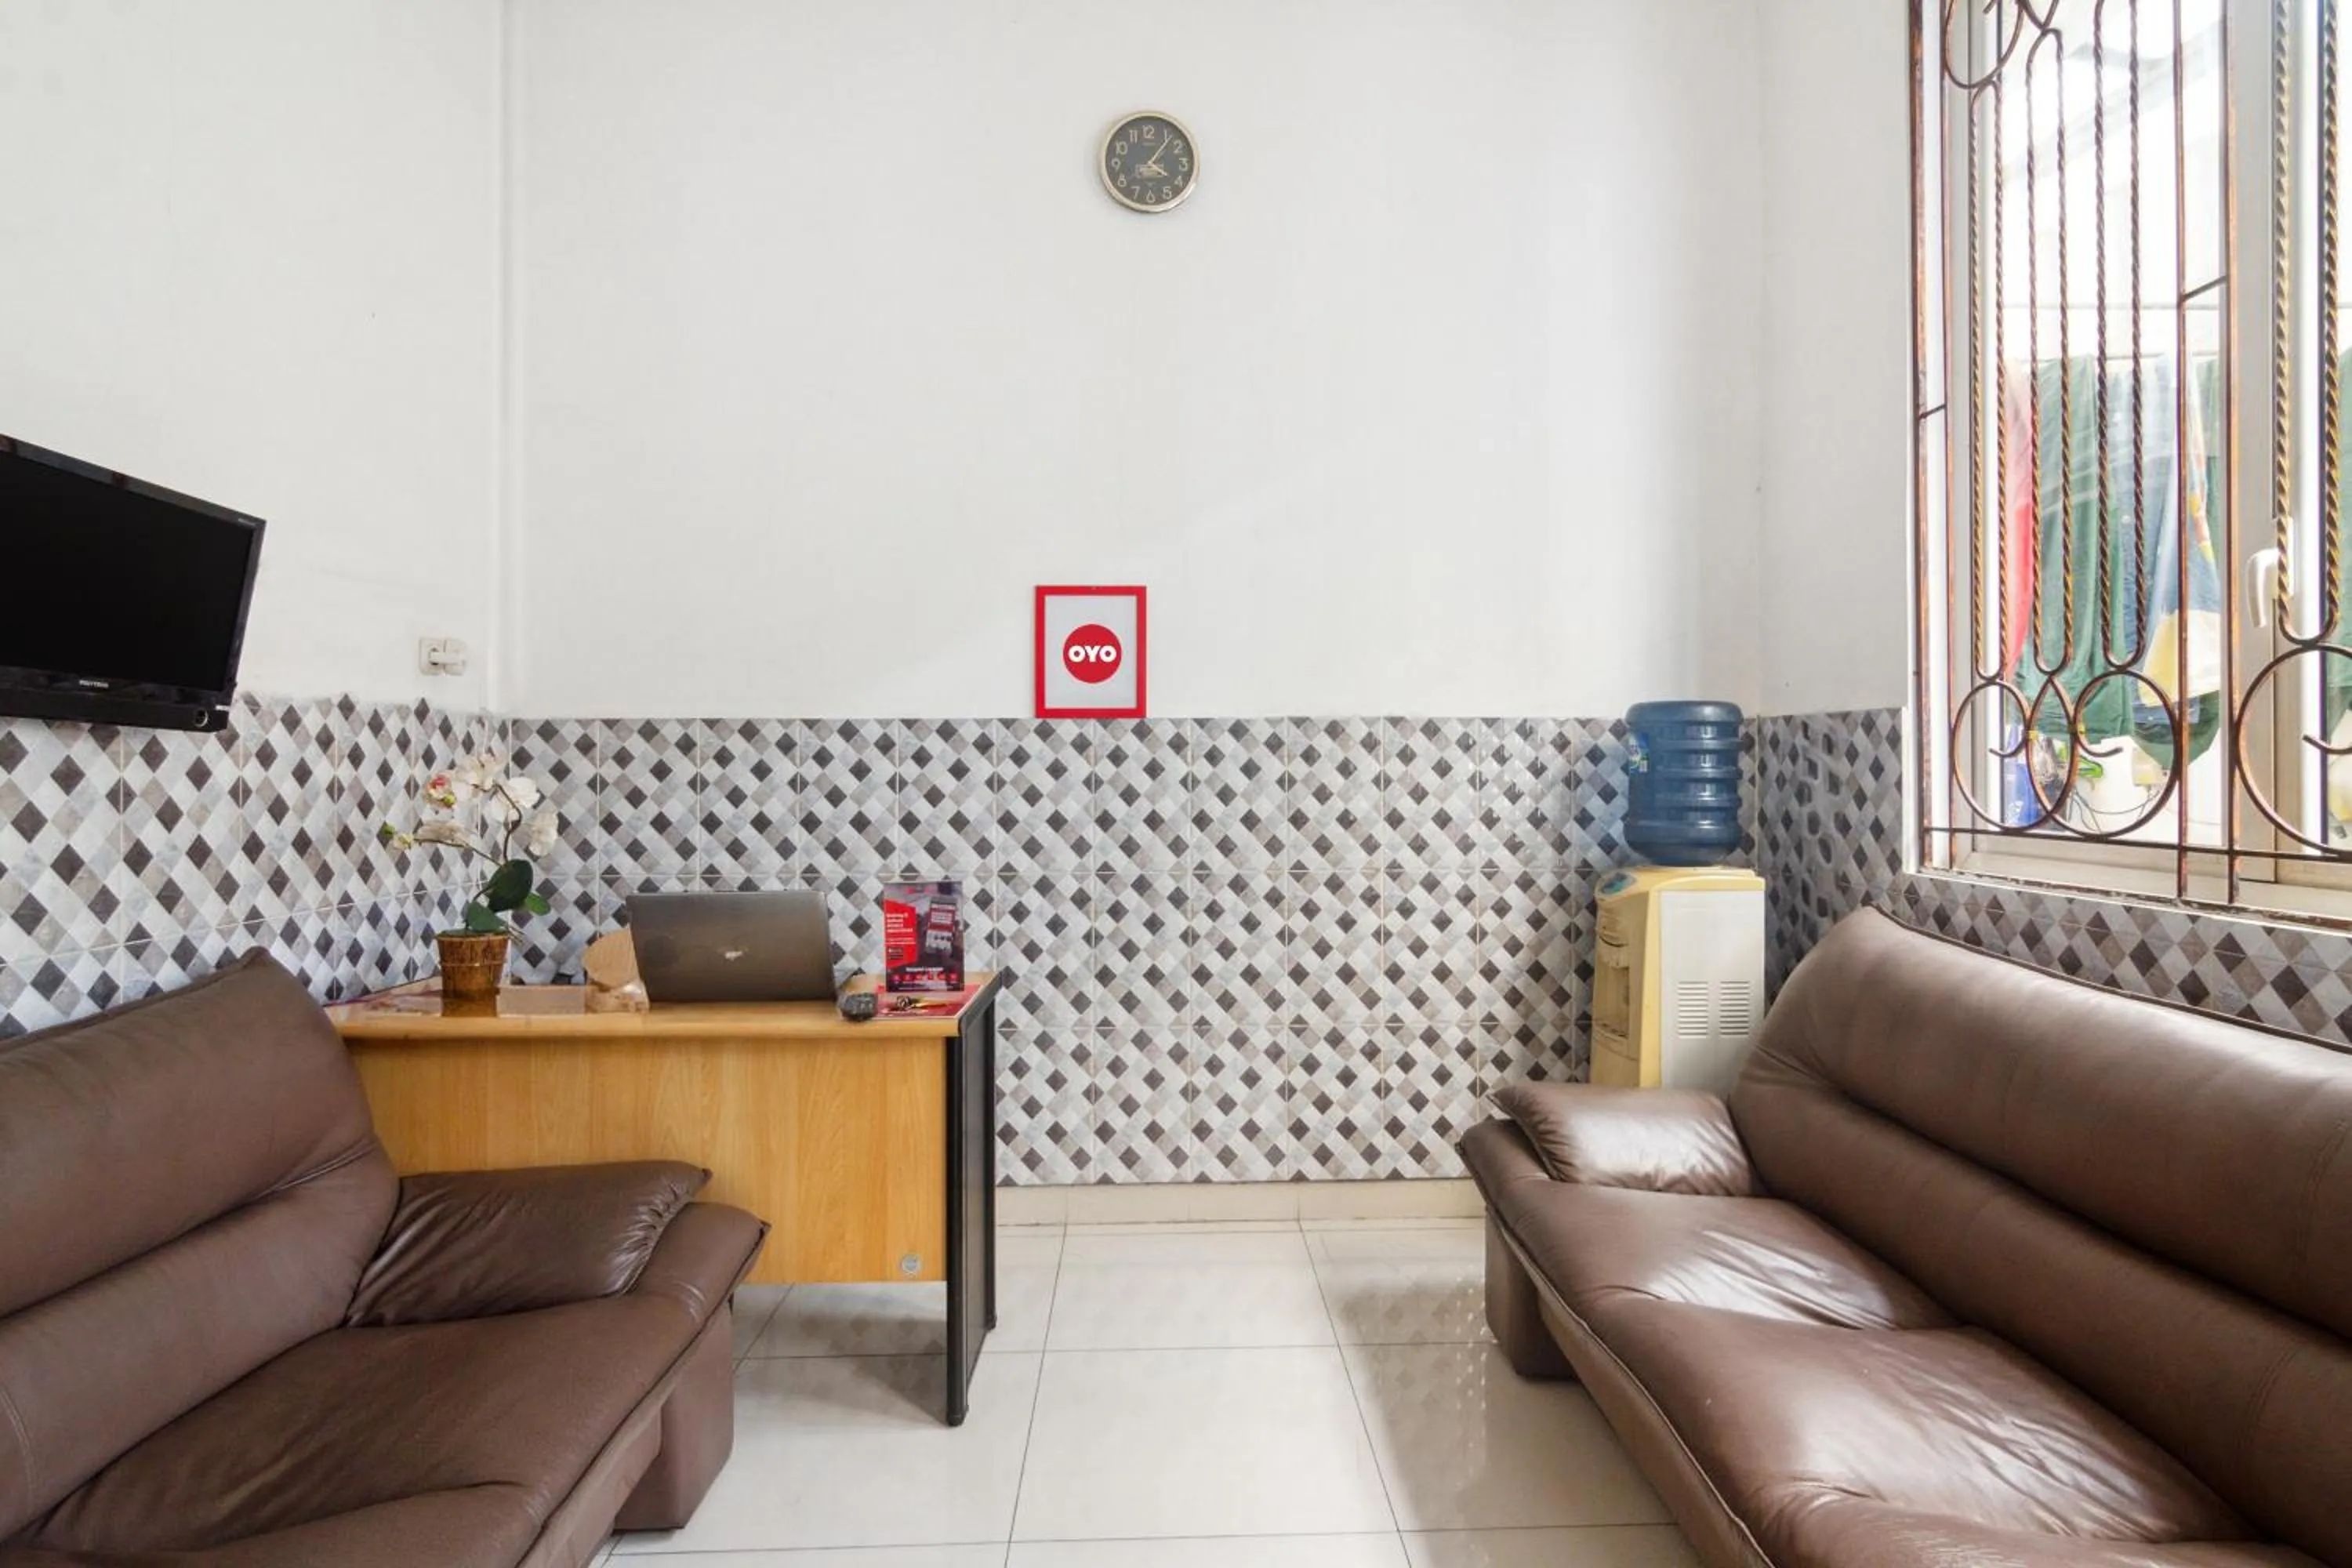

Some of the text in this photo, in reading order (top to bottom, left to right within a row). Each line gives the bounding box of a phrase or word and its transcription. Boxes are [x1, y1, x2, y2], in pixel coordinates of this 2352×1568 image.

[1129, 129, 1138, 143] 11
[1142, 125, 1155, 139] 12
[1116, 141, 1128, 155] 10
[1173, 140, 1183, 154] 2
[1111, 158, 1121, 172] 9
[1178, 158, 1189, 172] 3
[1117, 173, 1127, 187] 8
[1174, 175, 1184, 187] 4
[1131, 186, 1141, 200] 7
[1145, 187, 1156, 204] 6
[1163, 186, 1172, 199] 5
[1069, 644, 1117, 662] OYO
